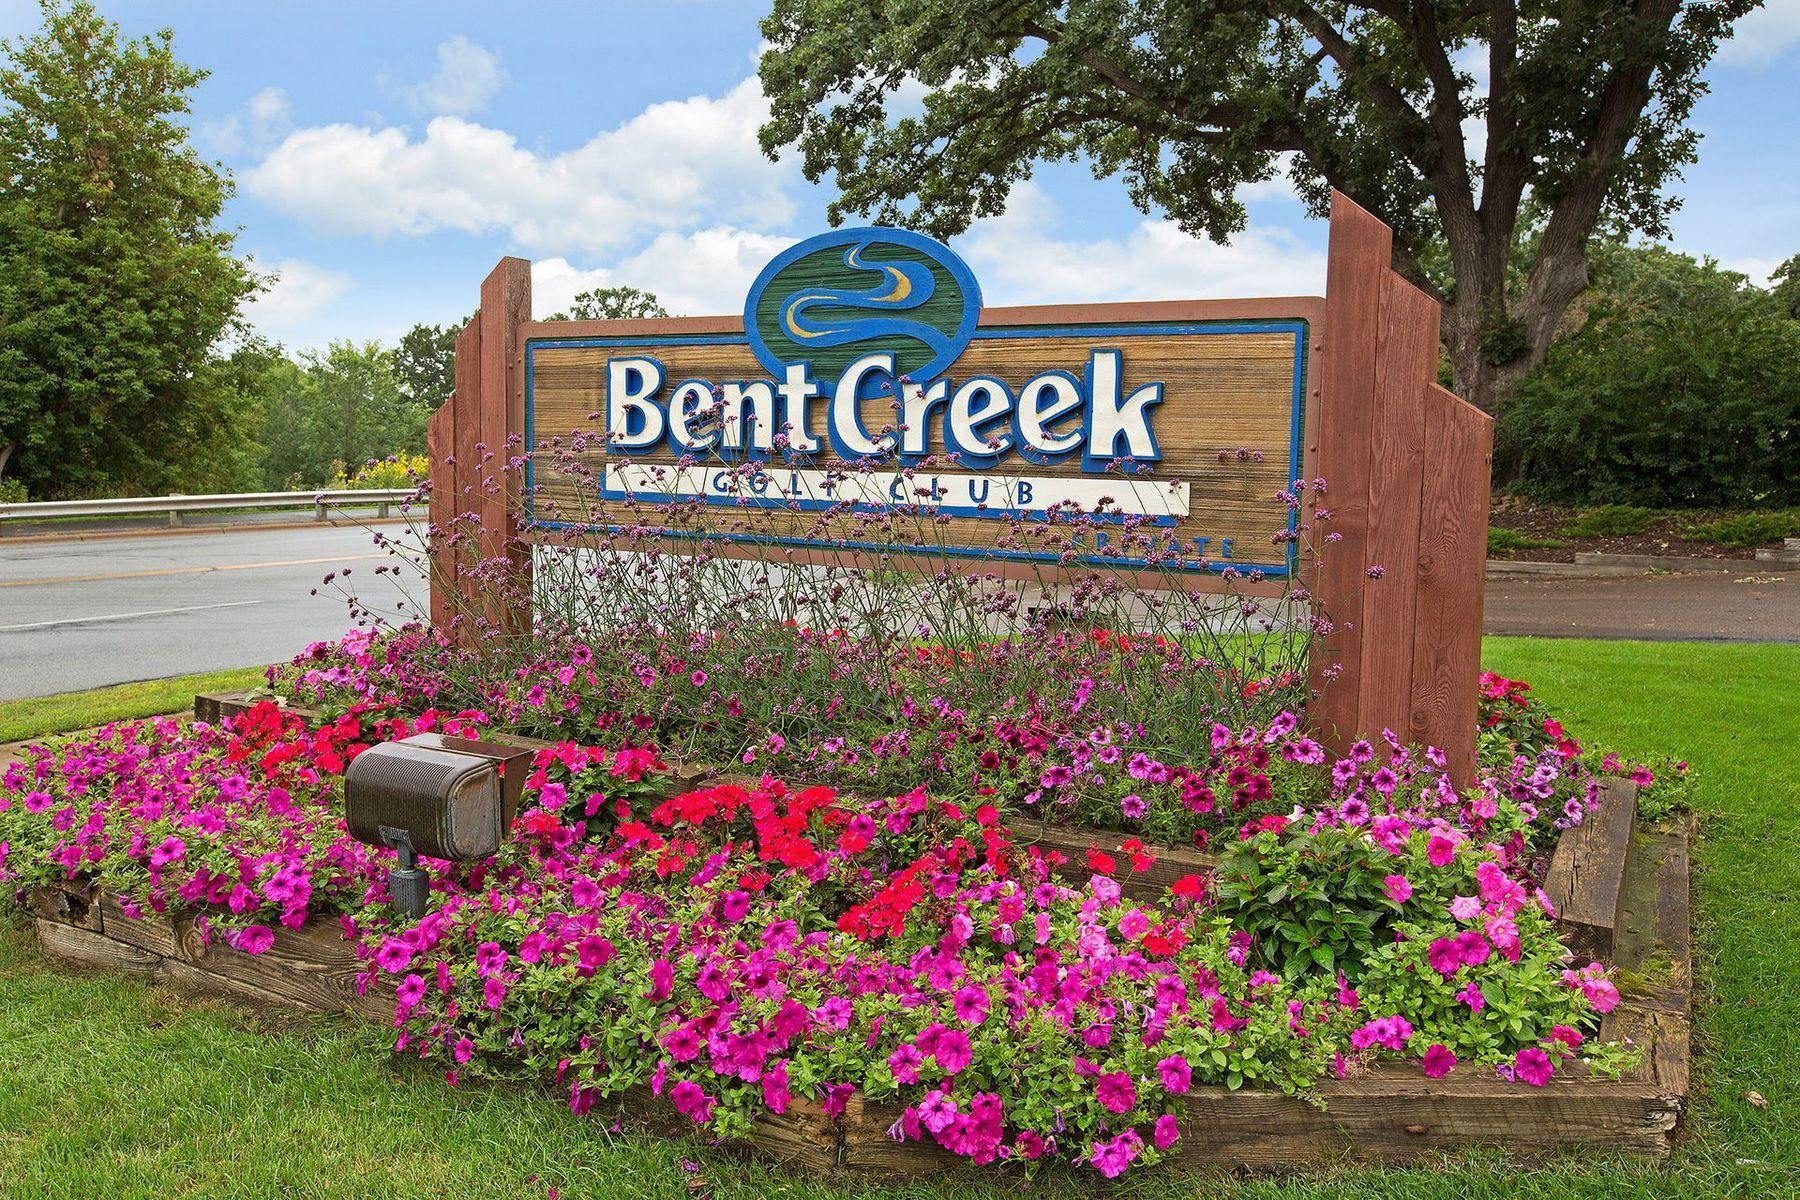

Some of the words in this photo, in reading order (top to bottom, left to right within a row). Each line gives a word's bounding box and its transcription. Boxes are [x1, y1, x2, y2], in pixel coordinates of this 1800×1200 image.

[712, 470, 838, 497] GOLF
[889, 476, 1034, 505] CLUB
[1071, 530, 1234, 559] PRATE
